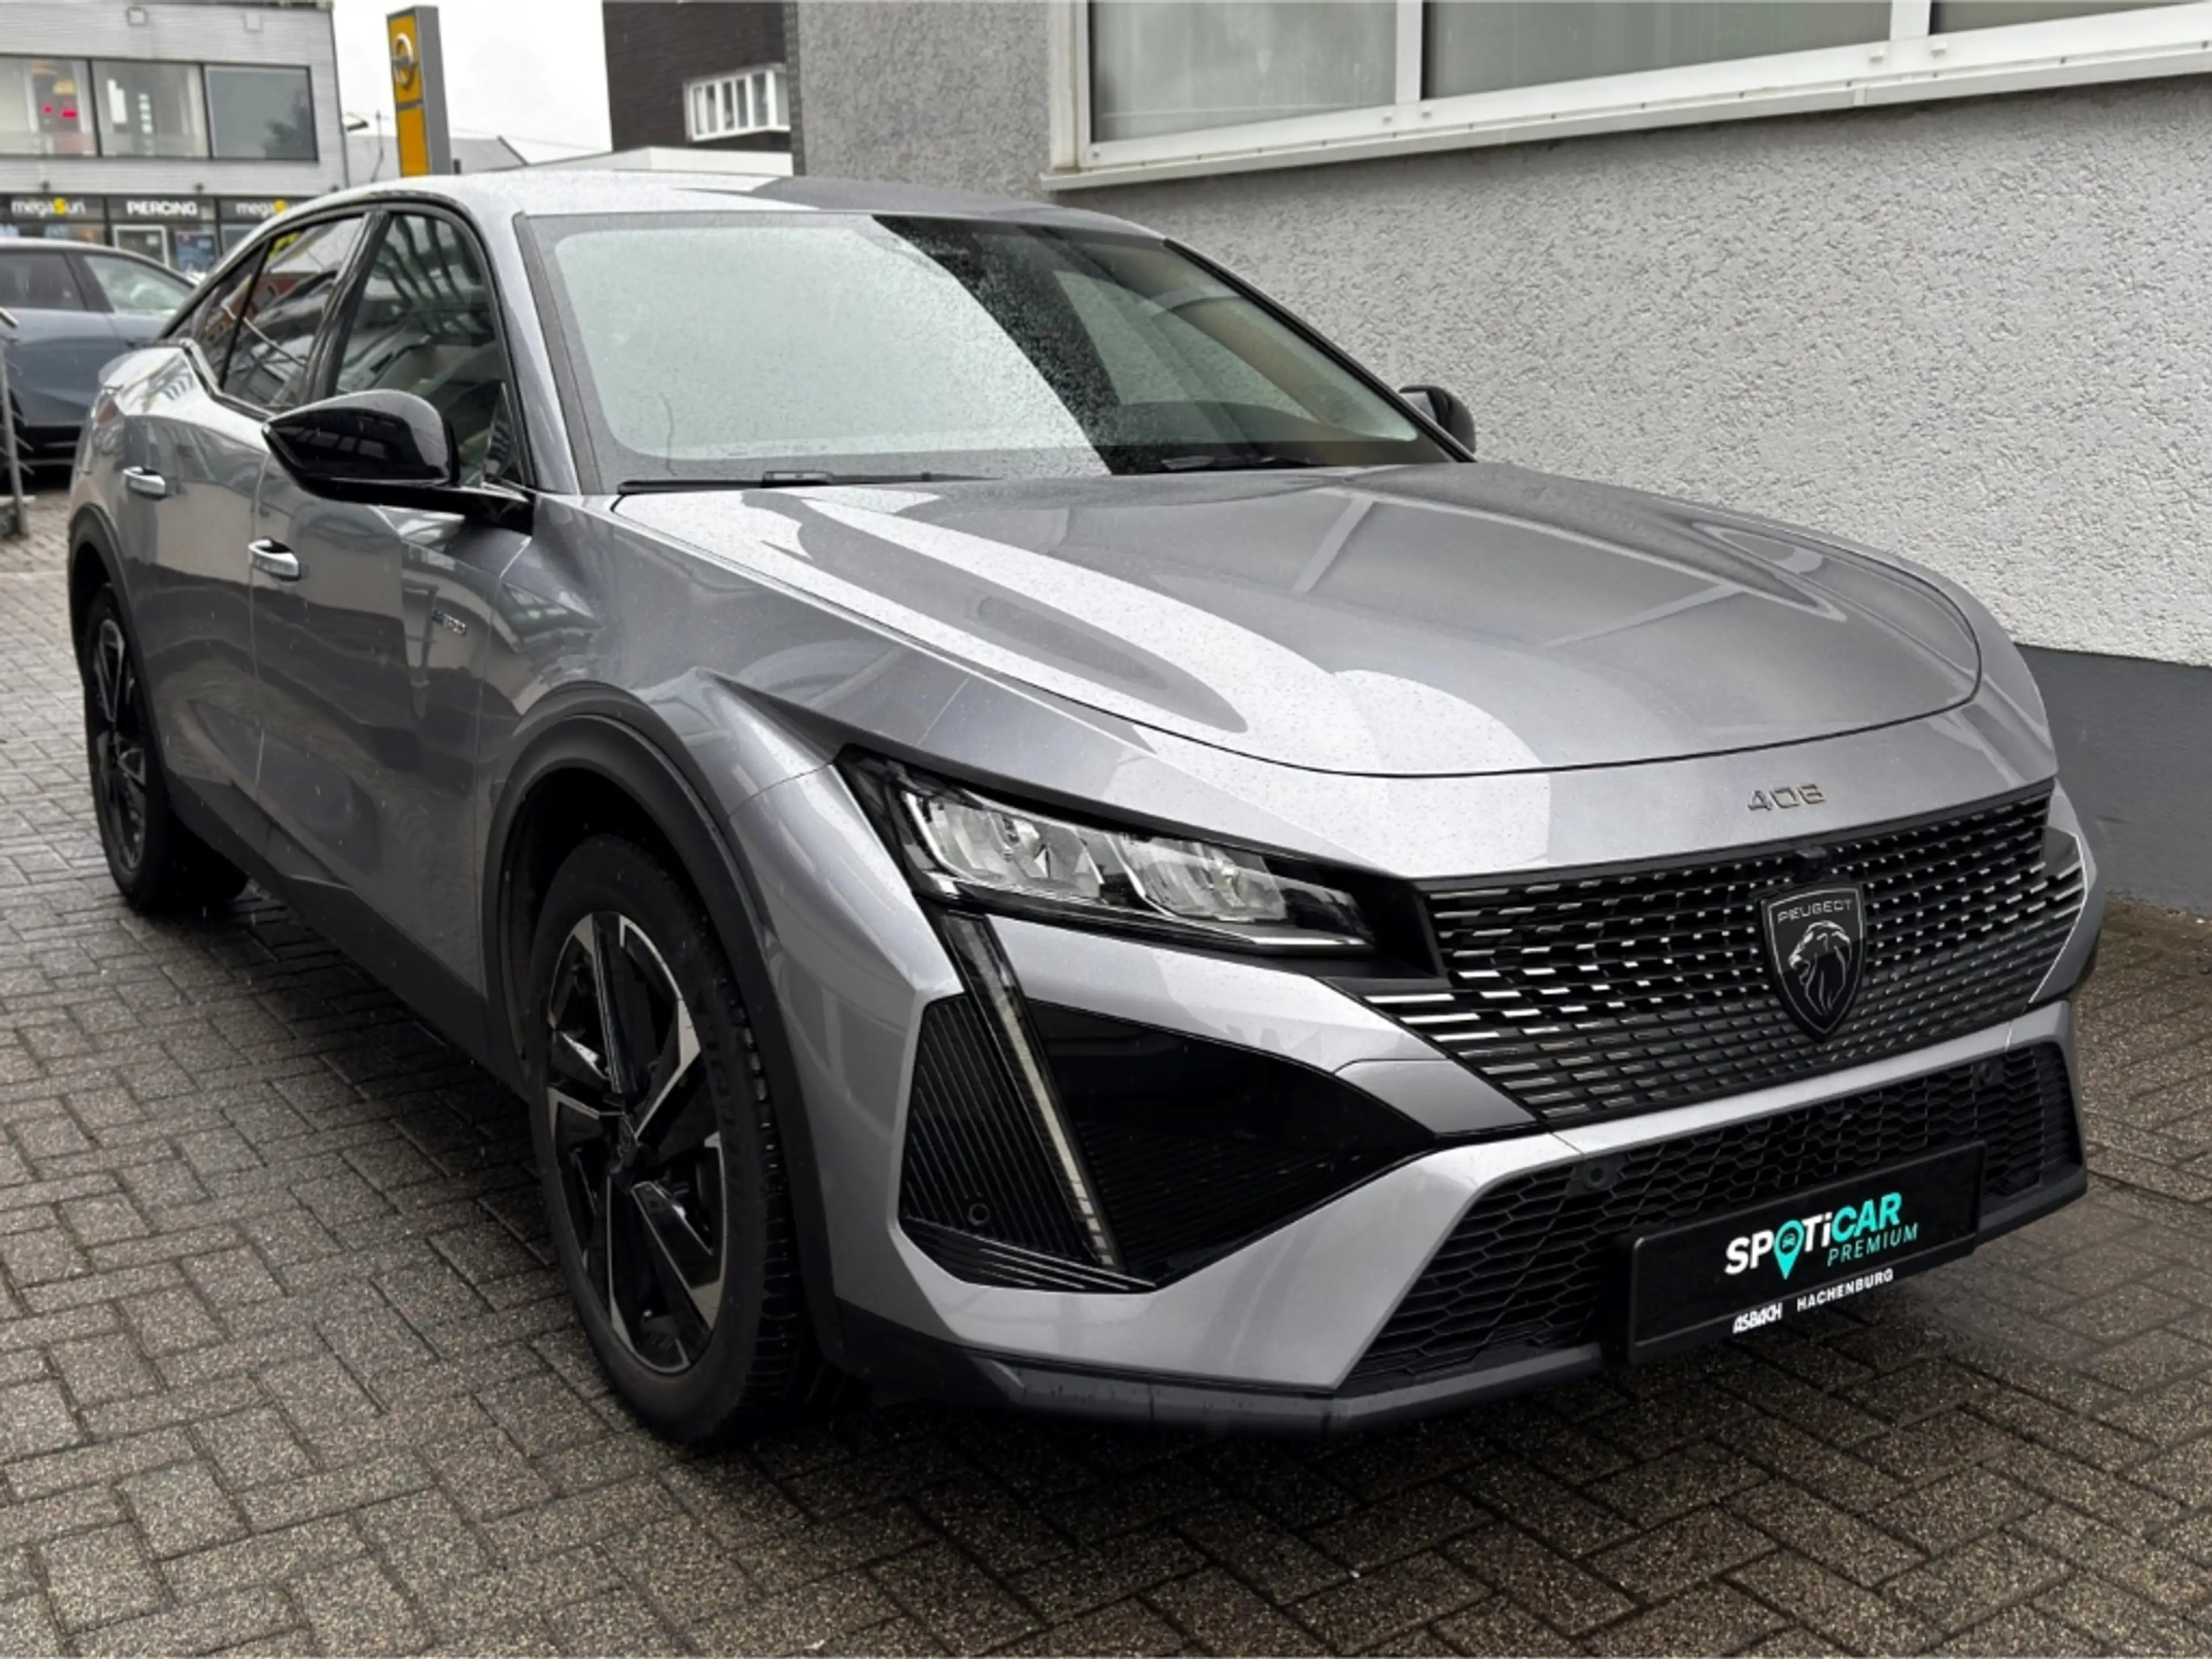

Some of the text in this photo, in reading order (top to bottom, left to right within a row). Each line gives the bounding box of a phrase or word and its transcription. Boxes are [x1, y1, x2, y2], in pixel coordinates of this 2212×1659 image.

[126, 200, 198, 216] PIERCING
[1748, 783, 1825, 810] 408
[1777, 899, 1853, 923] PEUGEOT
[1827, 1222, 1919, 1267] PREMIUM
[1733, 1268, 1894, 1334] ASBACH HACHENBURG
